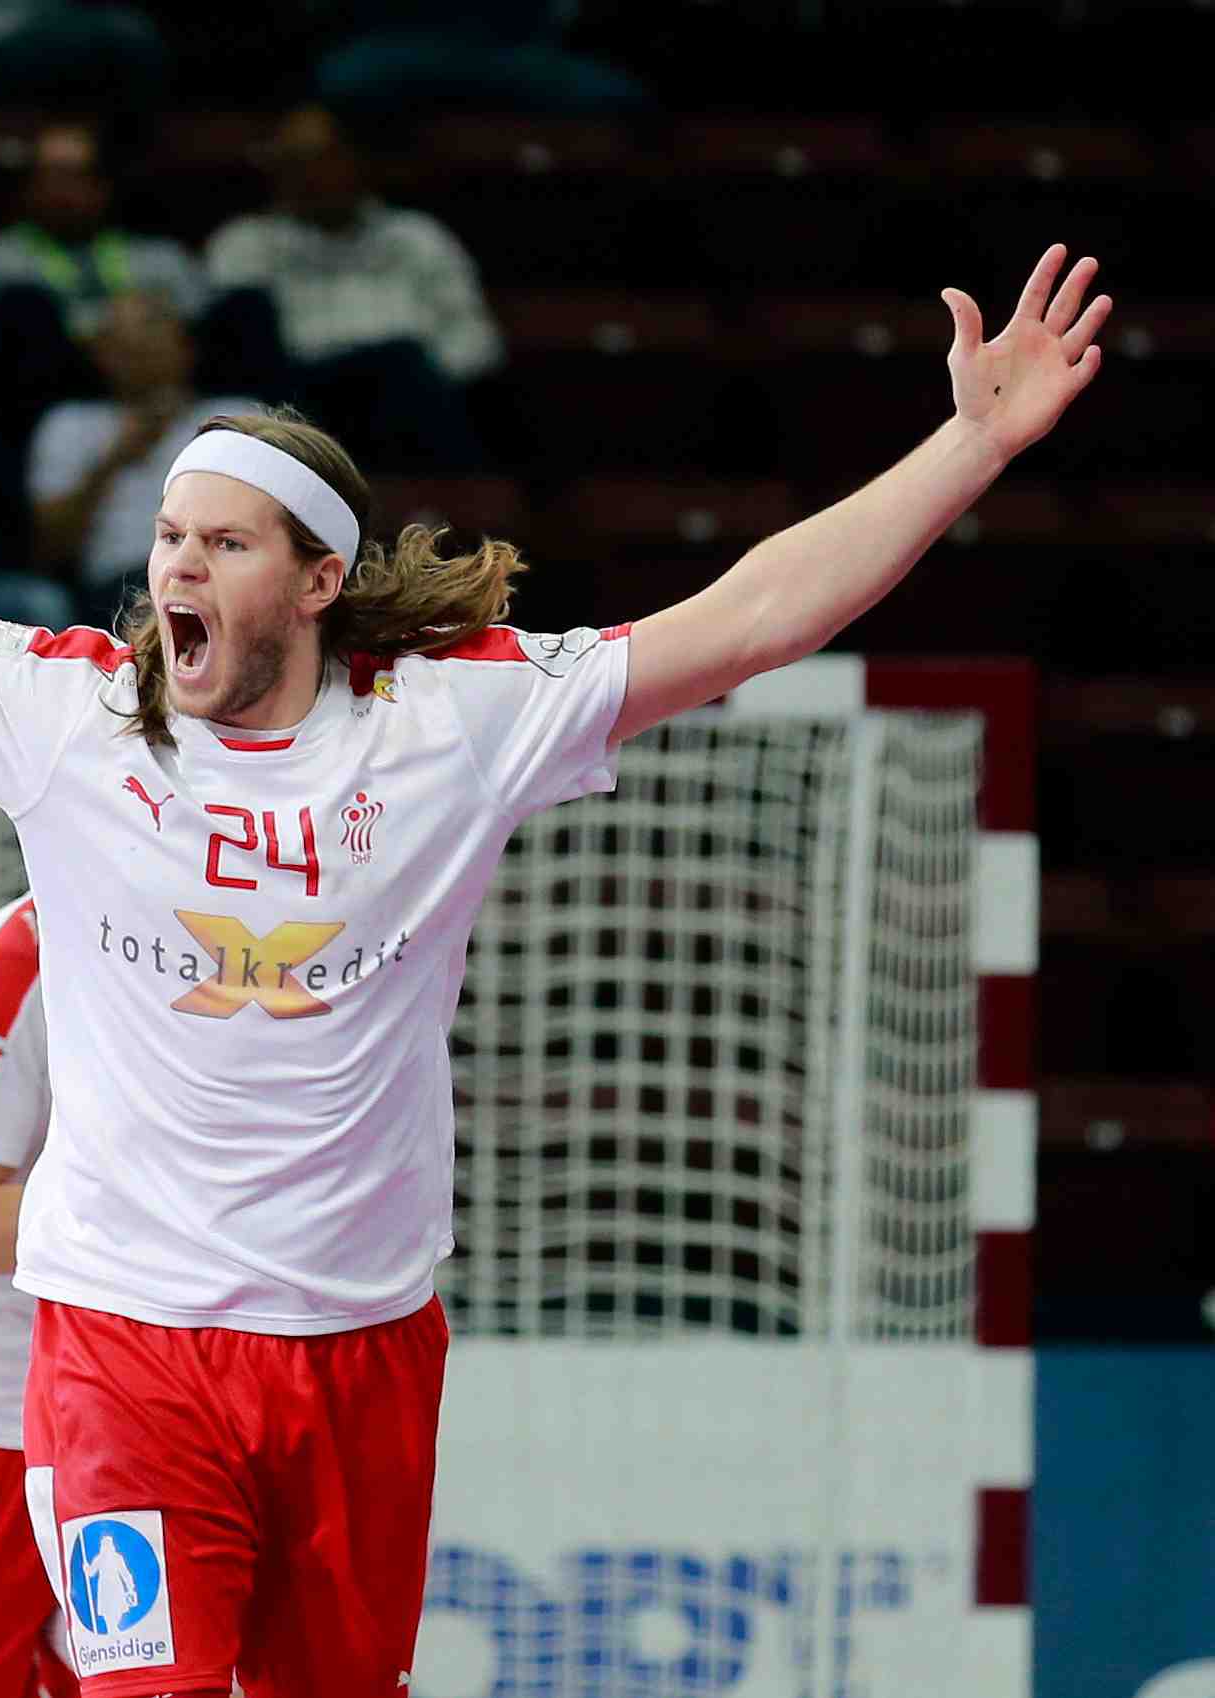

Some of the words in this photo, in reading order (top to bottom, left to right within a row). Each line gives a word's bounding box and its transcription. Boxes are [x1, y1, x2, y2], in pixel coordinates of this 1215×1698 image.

[204, 803, 319, 897] 24
[99, 913, 411, 991] totalkredit
[79, 1637, 167, 1670] Gjensidige
